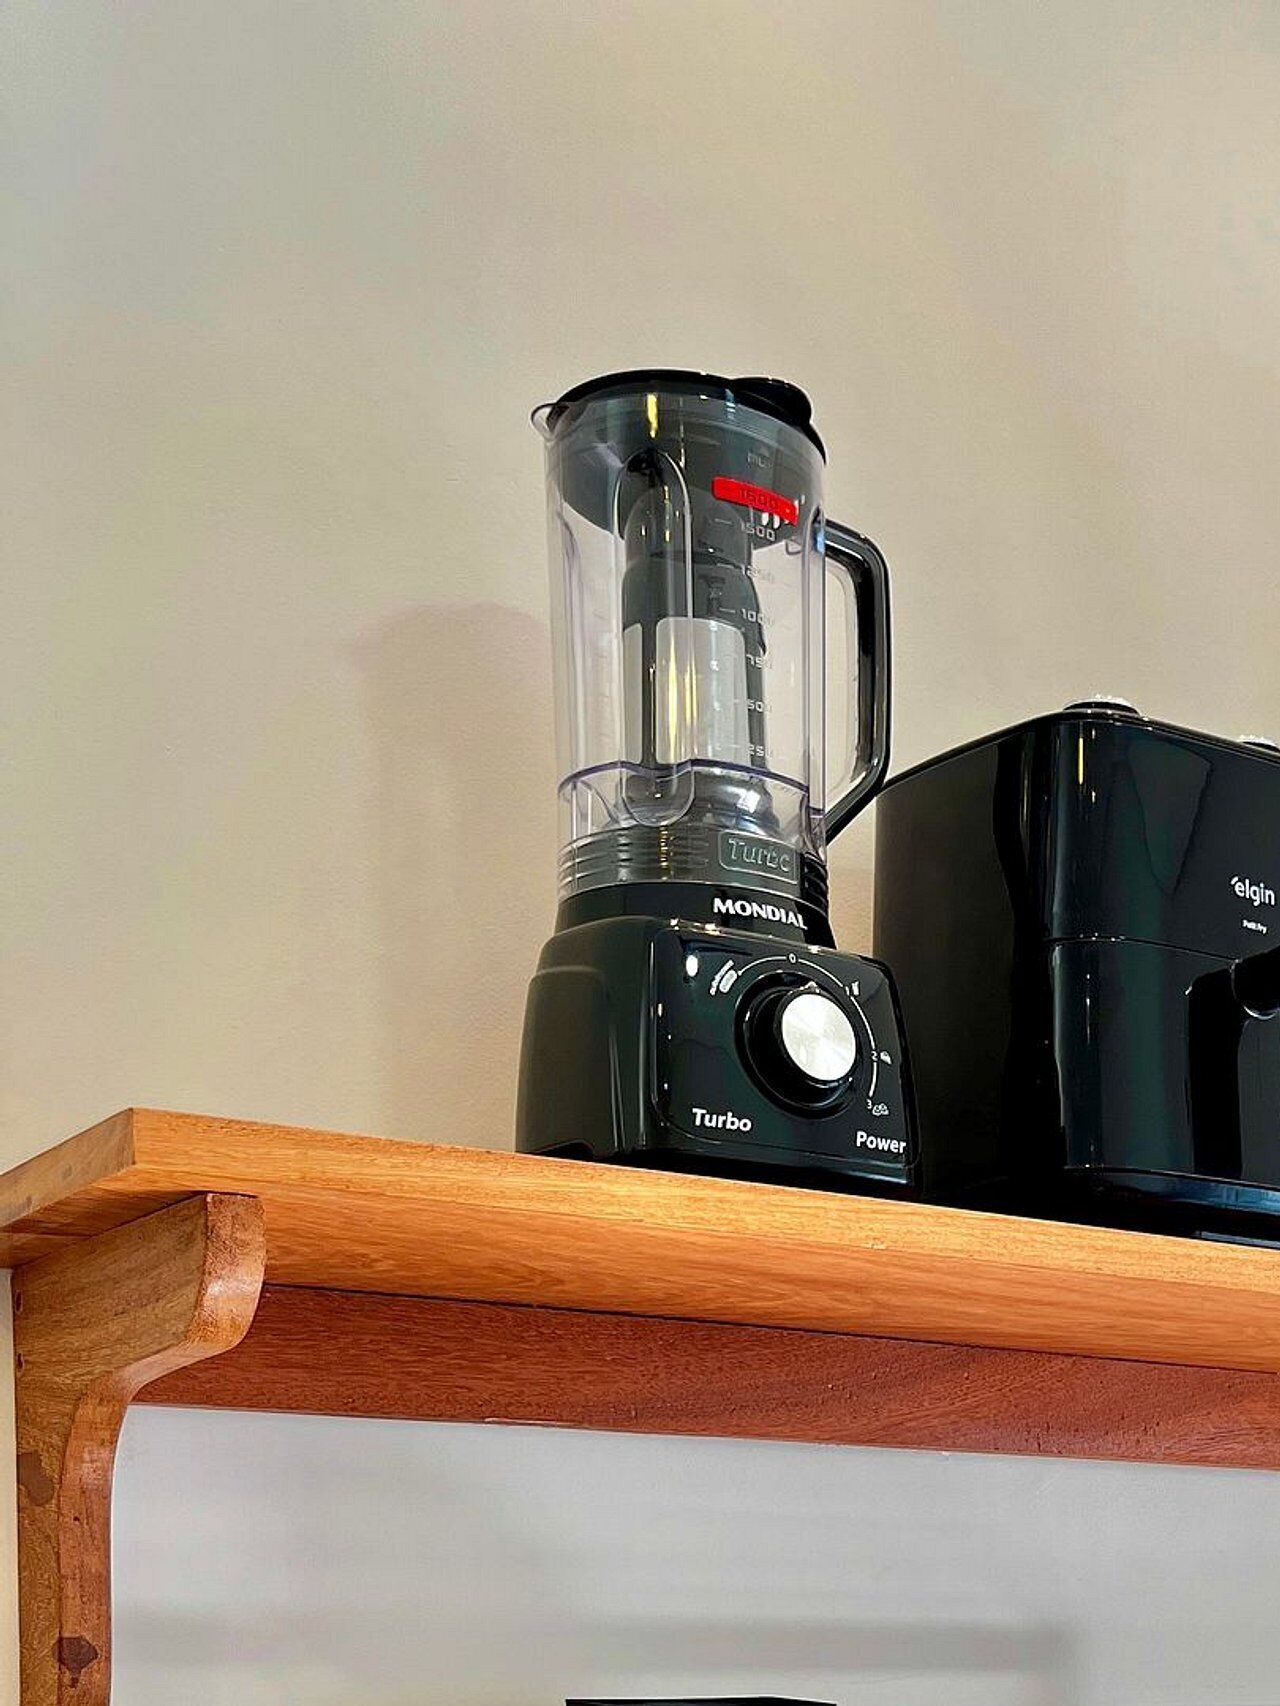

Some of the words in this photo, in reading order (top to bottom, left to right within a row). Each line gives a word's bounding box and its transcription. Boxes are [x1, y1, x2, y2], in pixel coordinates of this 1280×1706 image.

[713, 897, 808, 930] MONDIAL
[692, 1107, 752, 1132] Turbo
[856, 1131, 907, 1154] Power
